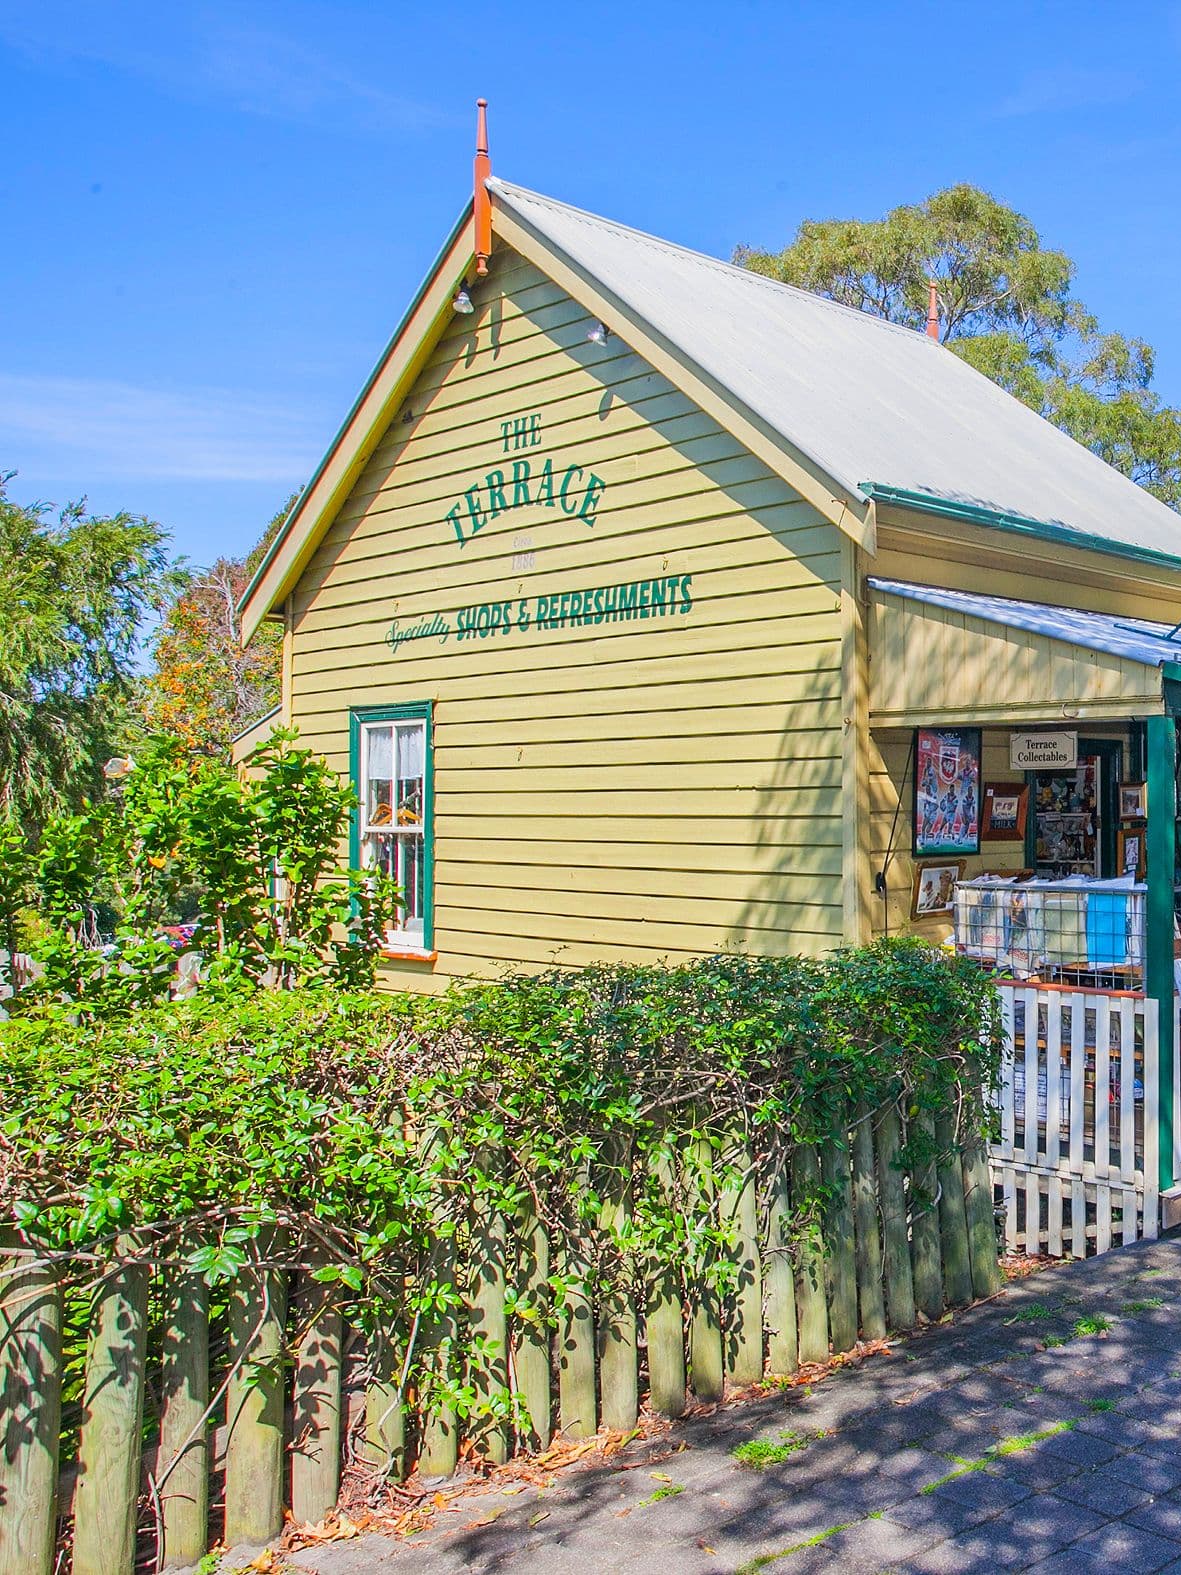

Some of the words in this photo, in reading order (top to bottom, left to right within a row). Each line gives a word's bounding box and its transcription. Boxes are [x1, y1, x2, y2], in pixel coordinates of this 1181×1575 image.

[501, 413, 542, 453] THE
[445, 459, 606, 550] TERRACE
[384, 613, 450, 654] Specialty
[456, 600, 513, 641] SHOPS
[518, 600, 531, 632] &
[536, 575, 694, 631] REFRESHMENTS
[1017, 751, 1068, 762] Collectables
[1025, 739, 1058, 749] Terrace
